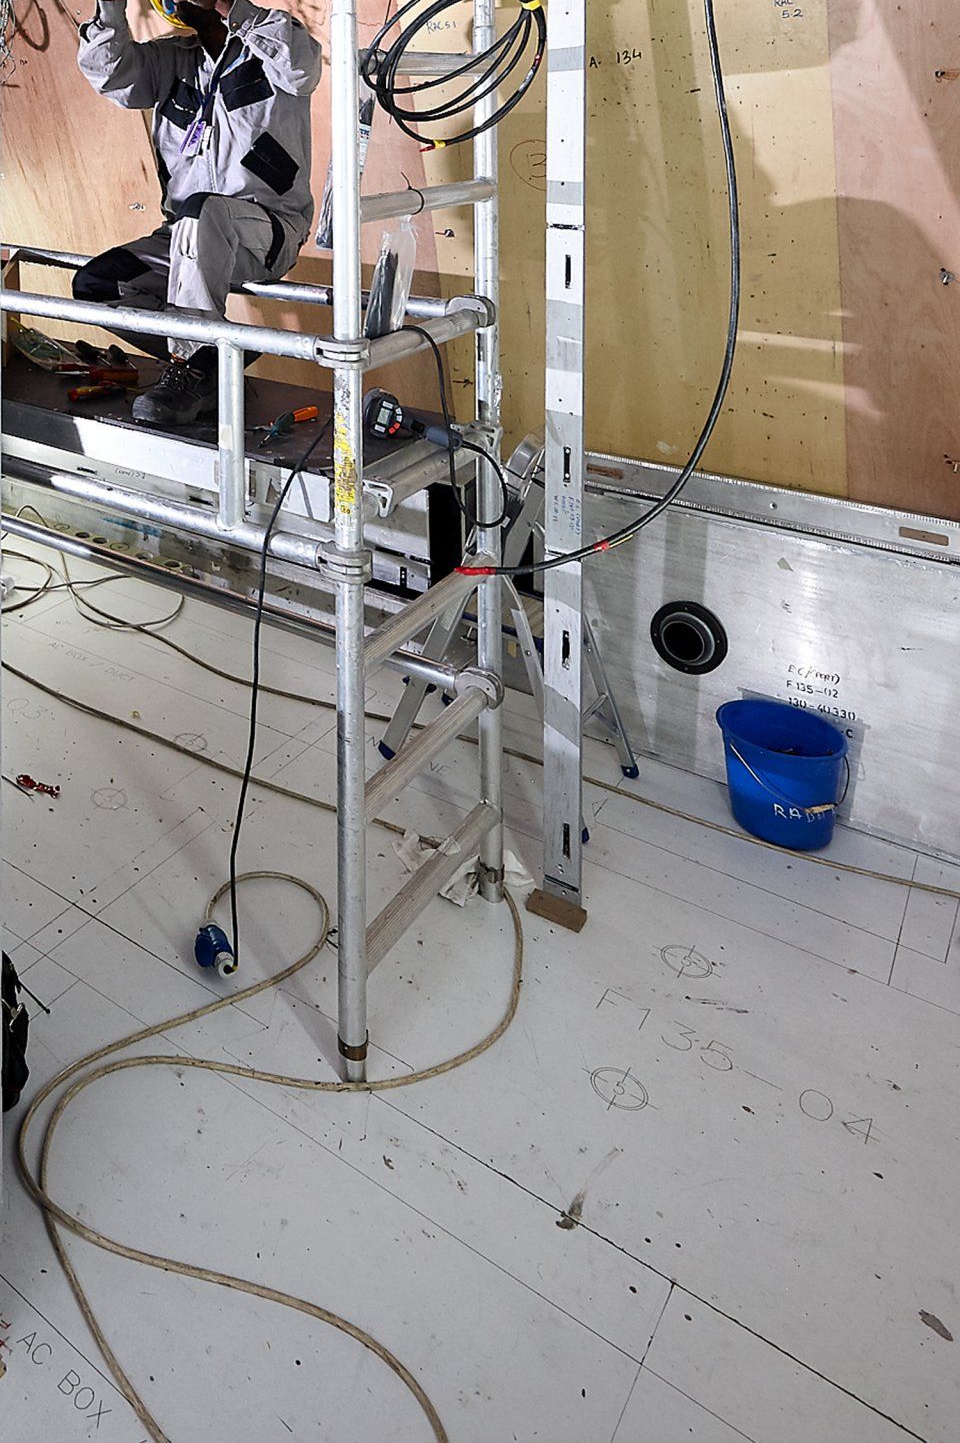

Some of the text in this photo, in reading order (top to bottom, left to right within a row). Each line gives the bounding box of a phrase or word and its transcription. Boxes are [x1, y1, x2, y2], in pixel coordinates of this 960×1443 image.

[616, 49, 642, 65] 134
[16, 1332, 112, 1429] AC BOX
